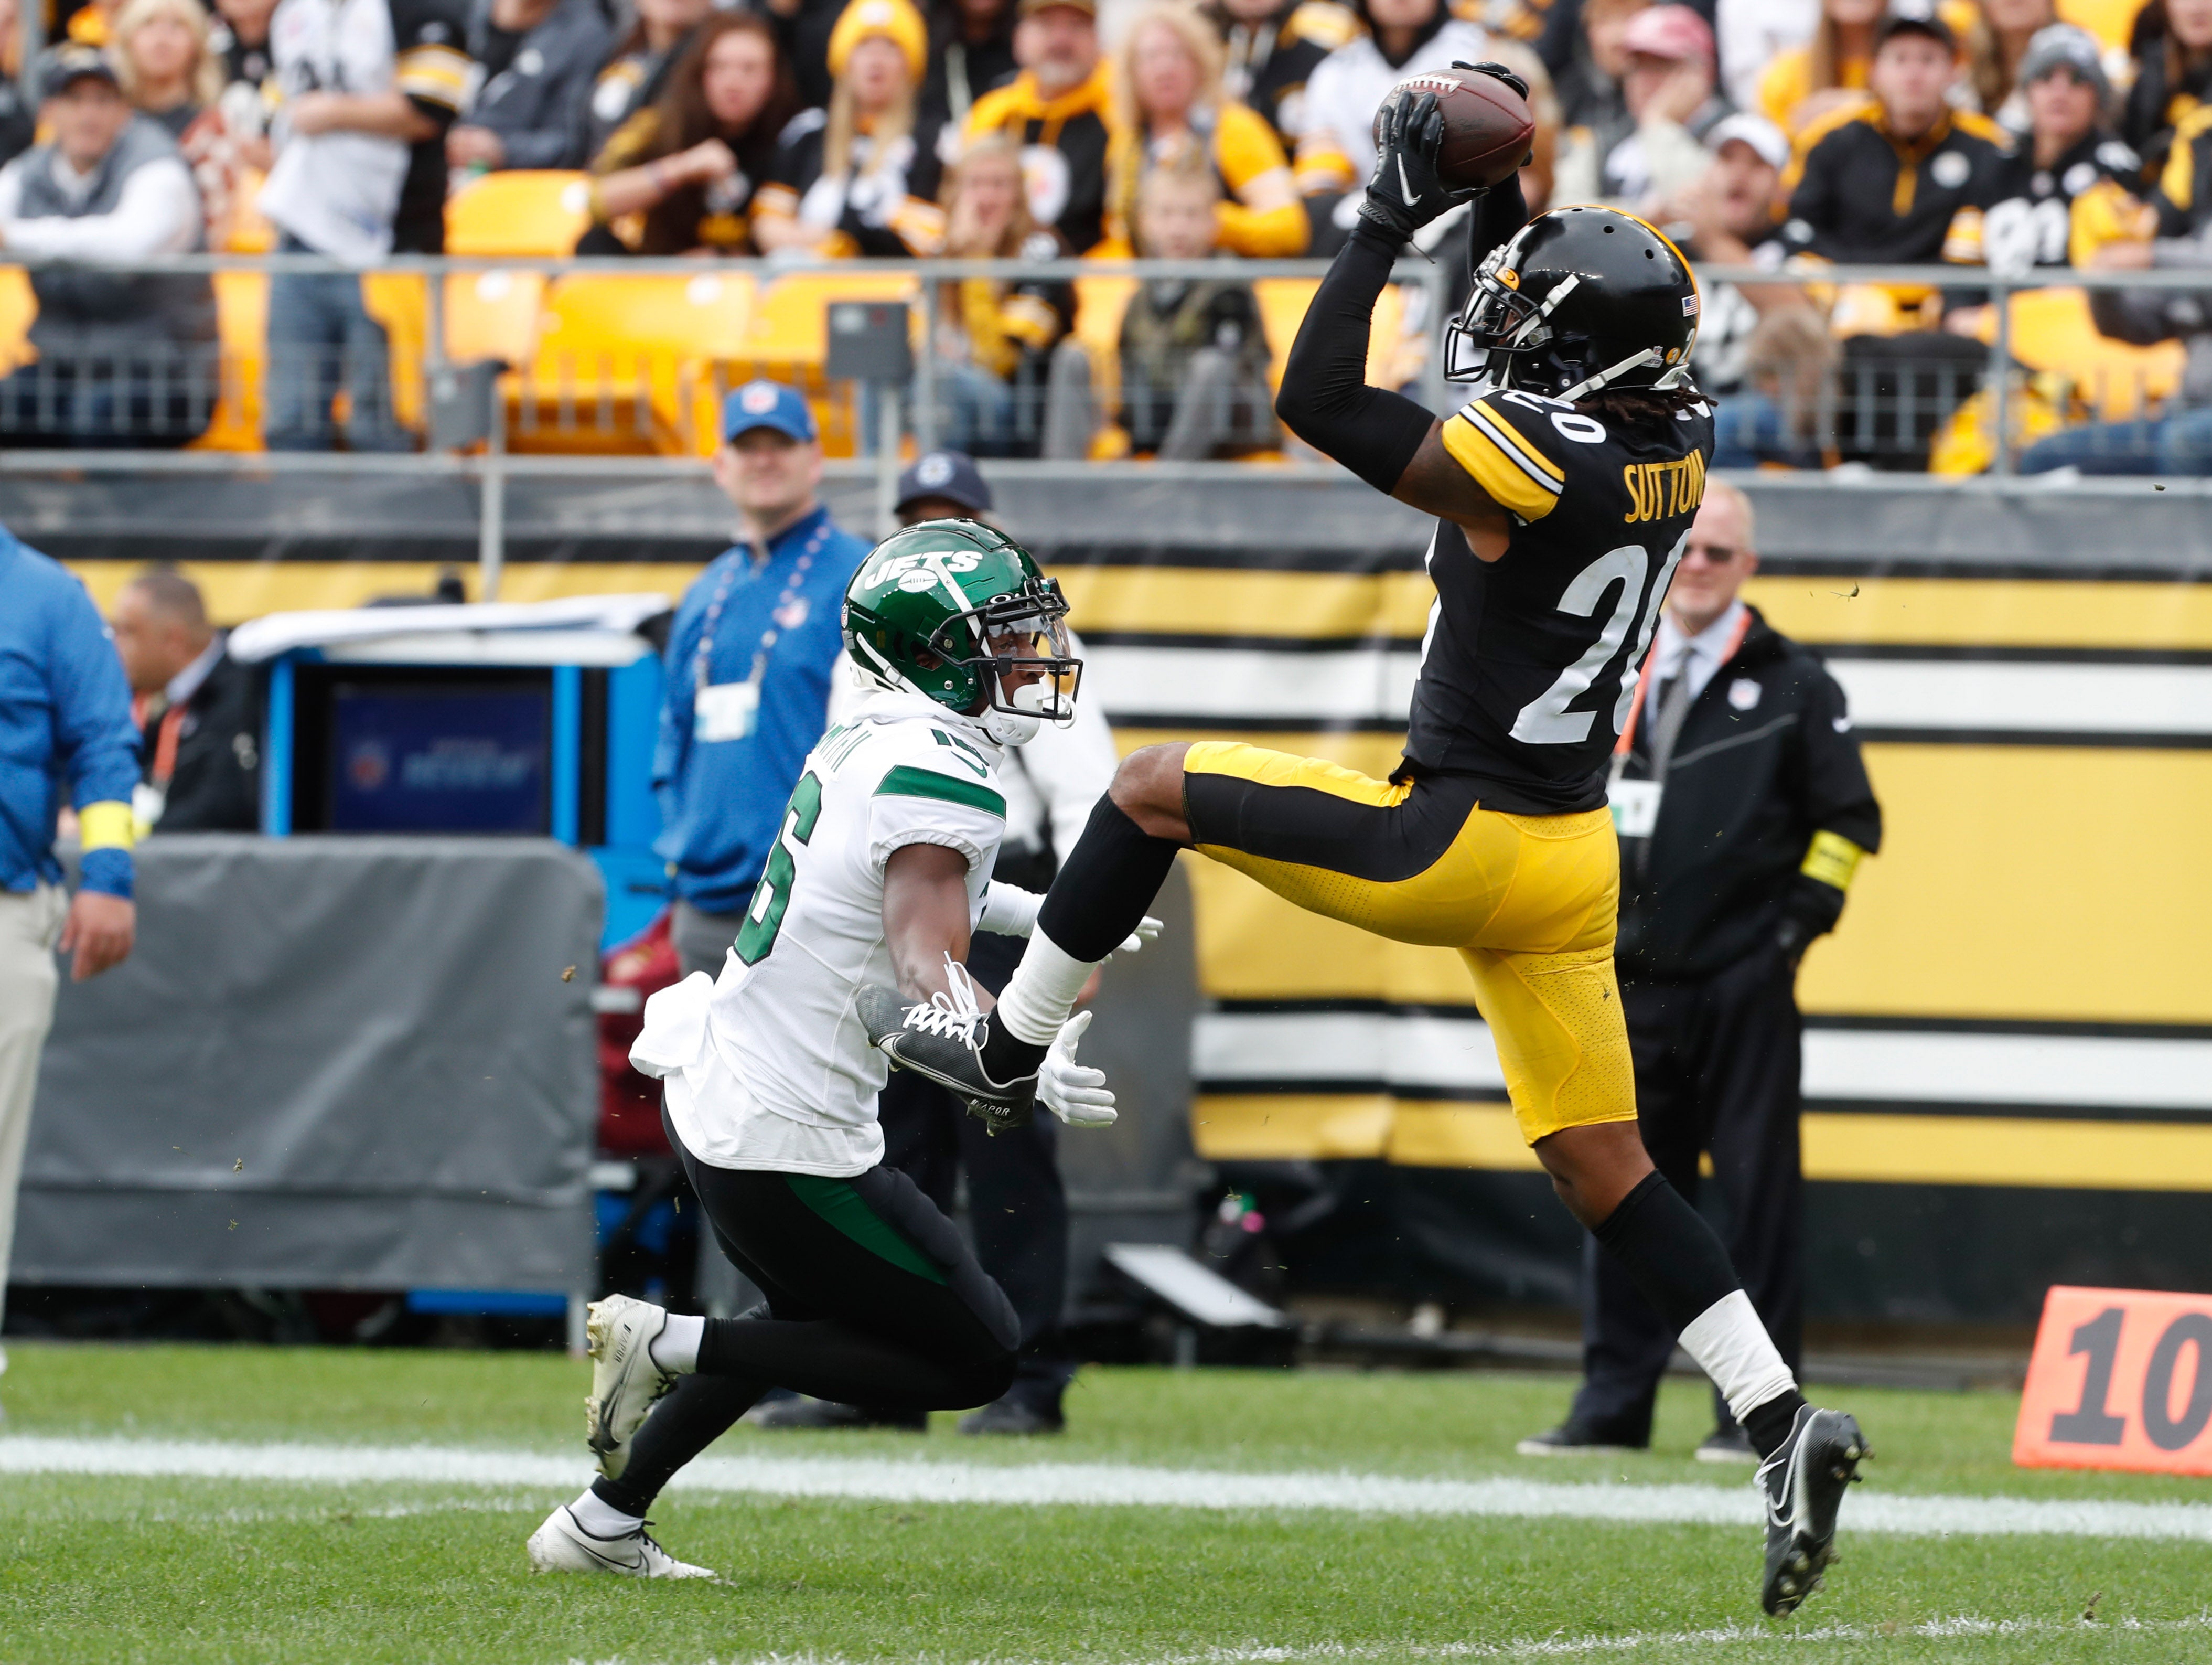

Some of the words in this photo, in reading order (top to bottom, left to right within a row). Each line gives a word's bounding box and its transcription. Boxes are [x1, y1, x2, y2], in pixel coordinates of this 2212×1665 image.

[1624, 449, 1705, 523] SUTTON
[864, 551, 983, 590] JETS
[2048, 1308, 2212, 1451] 10
